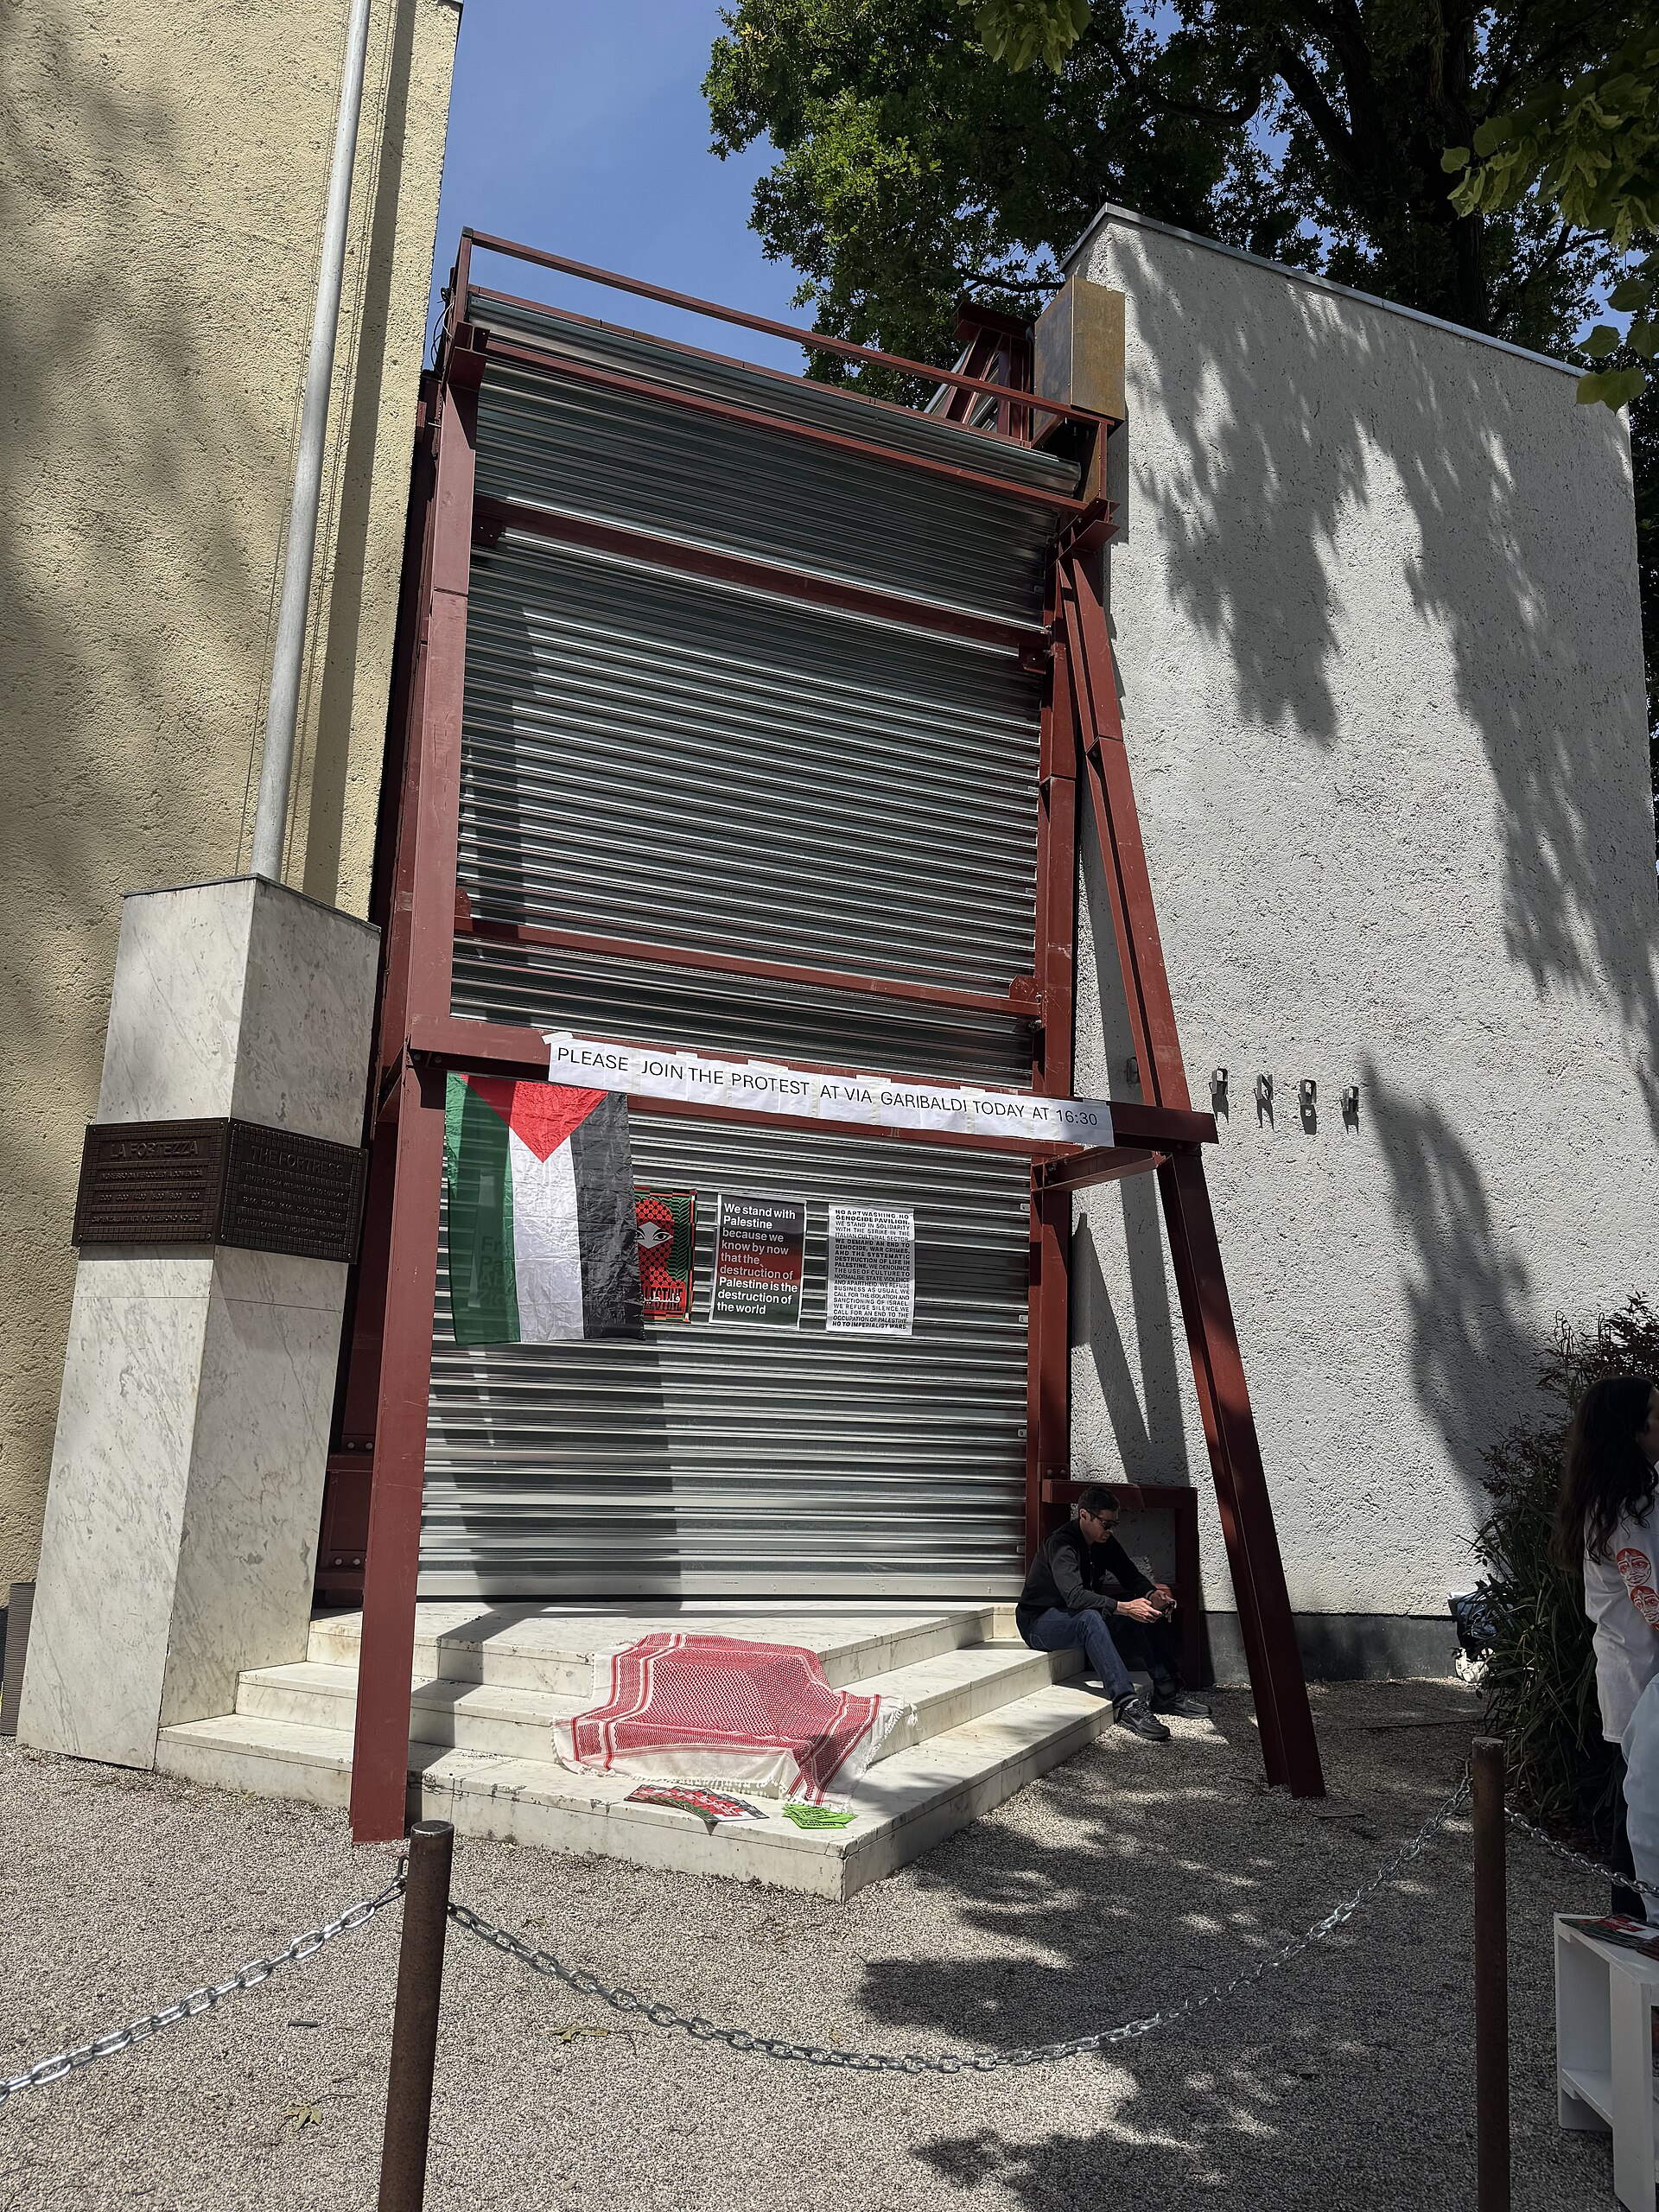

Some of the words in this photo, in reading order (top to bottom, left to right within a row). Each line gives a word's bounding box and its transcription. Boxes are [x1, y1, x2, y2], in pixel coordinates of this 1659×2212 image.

[557, 1047, 629, 1071] PLEASE
[641, 1058, 683, 1080] JOIN
[688, 1066, 723, 1084] THE
[731, 1072, 810, 1096] PROTEST
[820, 1084, 841, 1100] AT
[844, 1087, 874, 1103] VIA
[880, 1091, 967, 1112] GARIBALDI
[972, 1100, 1026, 1119] TODAY
[1032, 1104, 1052, 1121] AT
[1055, 1108, 1098, 1127] 16:30
[111, 1144, 127, 1159] LA
[131, 1141, 199, 1159] FORTEZZA
[251, 1145, 278, 1164] THE
[279, 1152, 345, 1178] FORTRESS
[724, 1203, 741, 1215] We
[741, 1205, 772, 1217] stand
[773, 1207, 796, 1220] with
[723, 1216, 772, 1229] Palestine
[722, 1227, 768, 1242] because
[769, 1233, 784, 1243] we
[721, 1239, 751, 1251] know
[752, 1241, 765, 1255] by
[766, 1244, 789, 1255] now
[721, 1251, 741, 1264] that
[742, 1254, 760, 1265] the
[720, 1263, 780, 1279] destruction
[782, 1269, 794, 1280] of
[719, 1277, 768, 1291] Palestine
[770, 1281, 779, 1291] is
[780, 1281, 798, 1293] the
[718, 1288, 779, 1303] destruction
[781, 1294, 792, 1305] of
[717, 1301, 735, 1313] the
[736, 1302, 766, 1315] world
